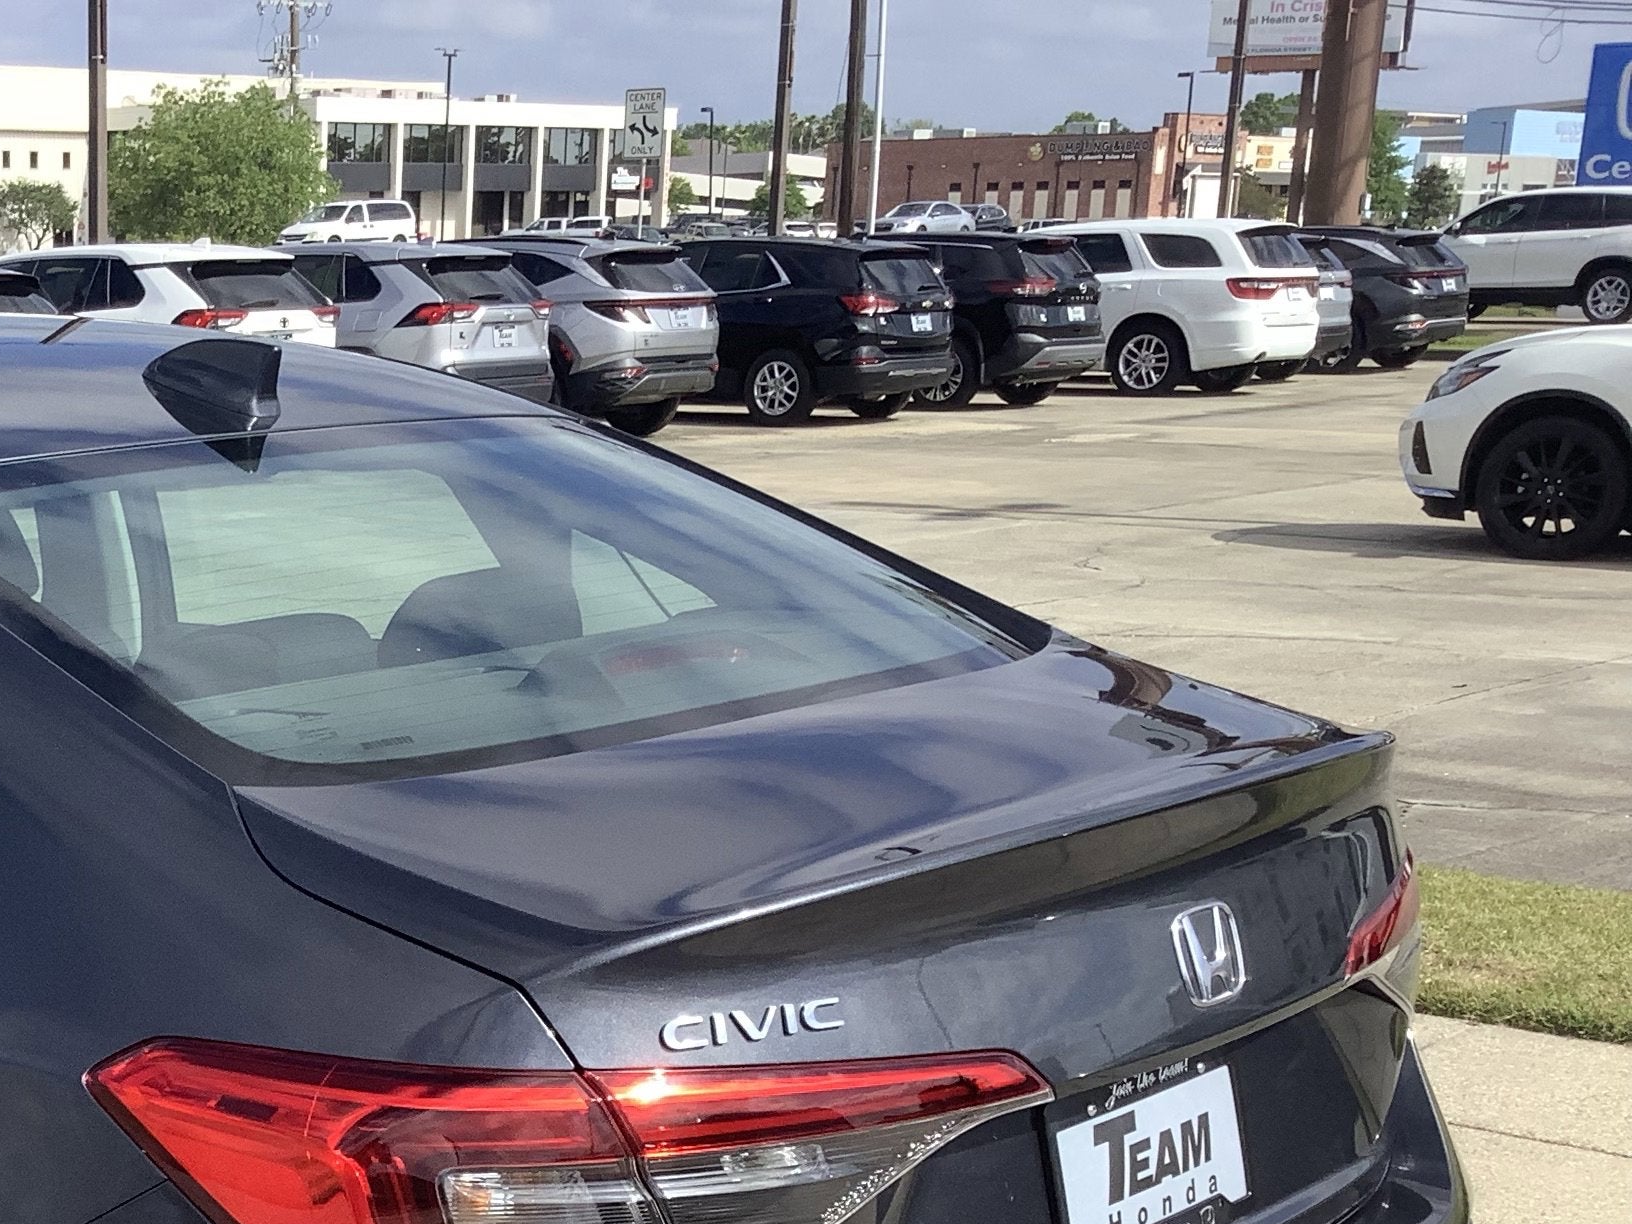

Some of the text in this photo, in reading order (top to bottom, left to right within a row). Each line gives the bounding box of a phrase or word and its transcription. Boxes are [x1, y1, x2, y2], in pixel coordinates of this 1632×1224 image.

[1270, 0, 1327, 13] In Cris
[1222, 16, 1258, 26] Meal
[1261, 14, 1296, 25] Health
[1298, 15, 1310, 24] or
[629, 92, 662, 102] CENTER
[633, 102, 657, 112] LANE
[631, 146, 654, 155] ONLY
[1125, 139, 1151, 152] BAO
[659, 997, 845, 1051] CIVIC
[1093, 1109, 1212, 1206] TEAM
